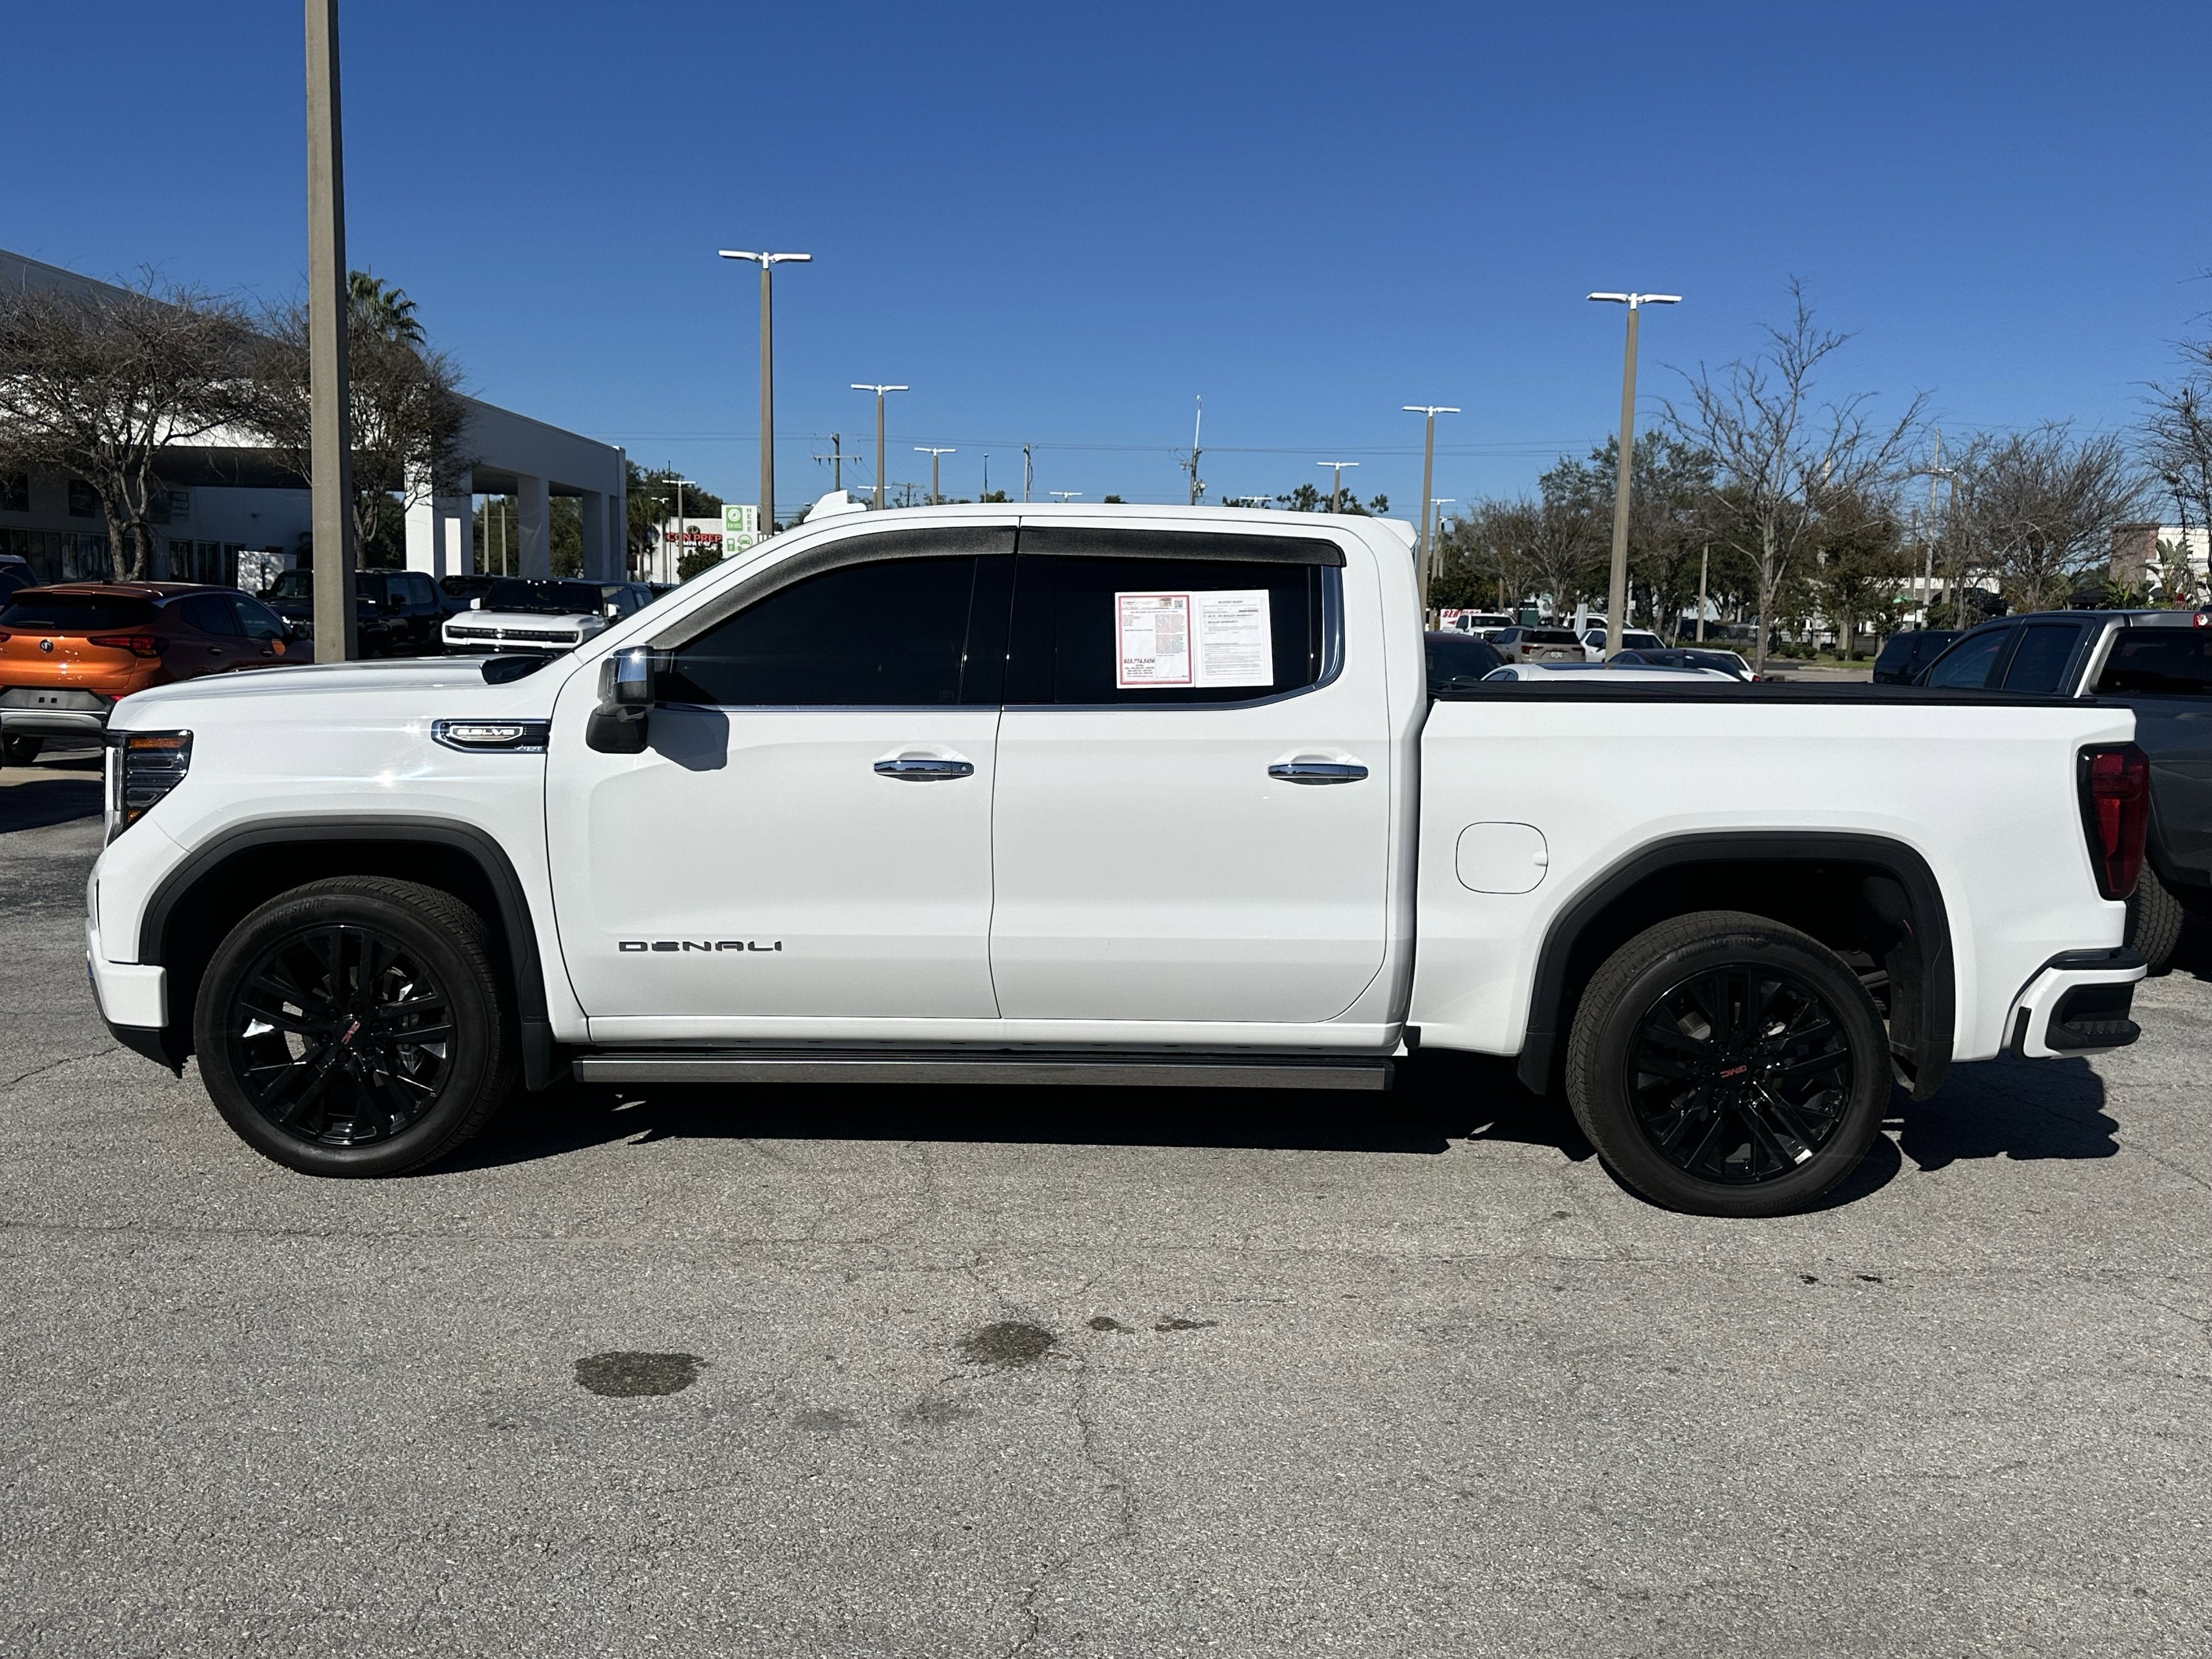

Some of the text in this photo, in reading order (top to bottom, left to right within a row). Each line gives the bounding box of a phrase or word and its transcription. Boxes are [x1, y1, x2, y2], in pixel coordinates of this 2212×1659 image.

[666, 533, 721, 543] CON PREP
[619, 941, 782, 952] DENALI
[1719, 1065, 1747, 1078] GMC
